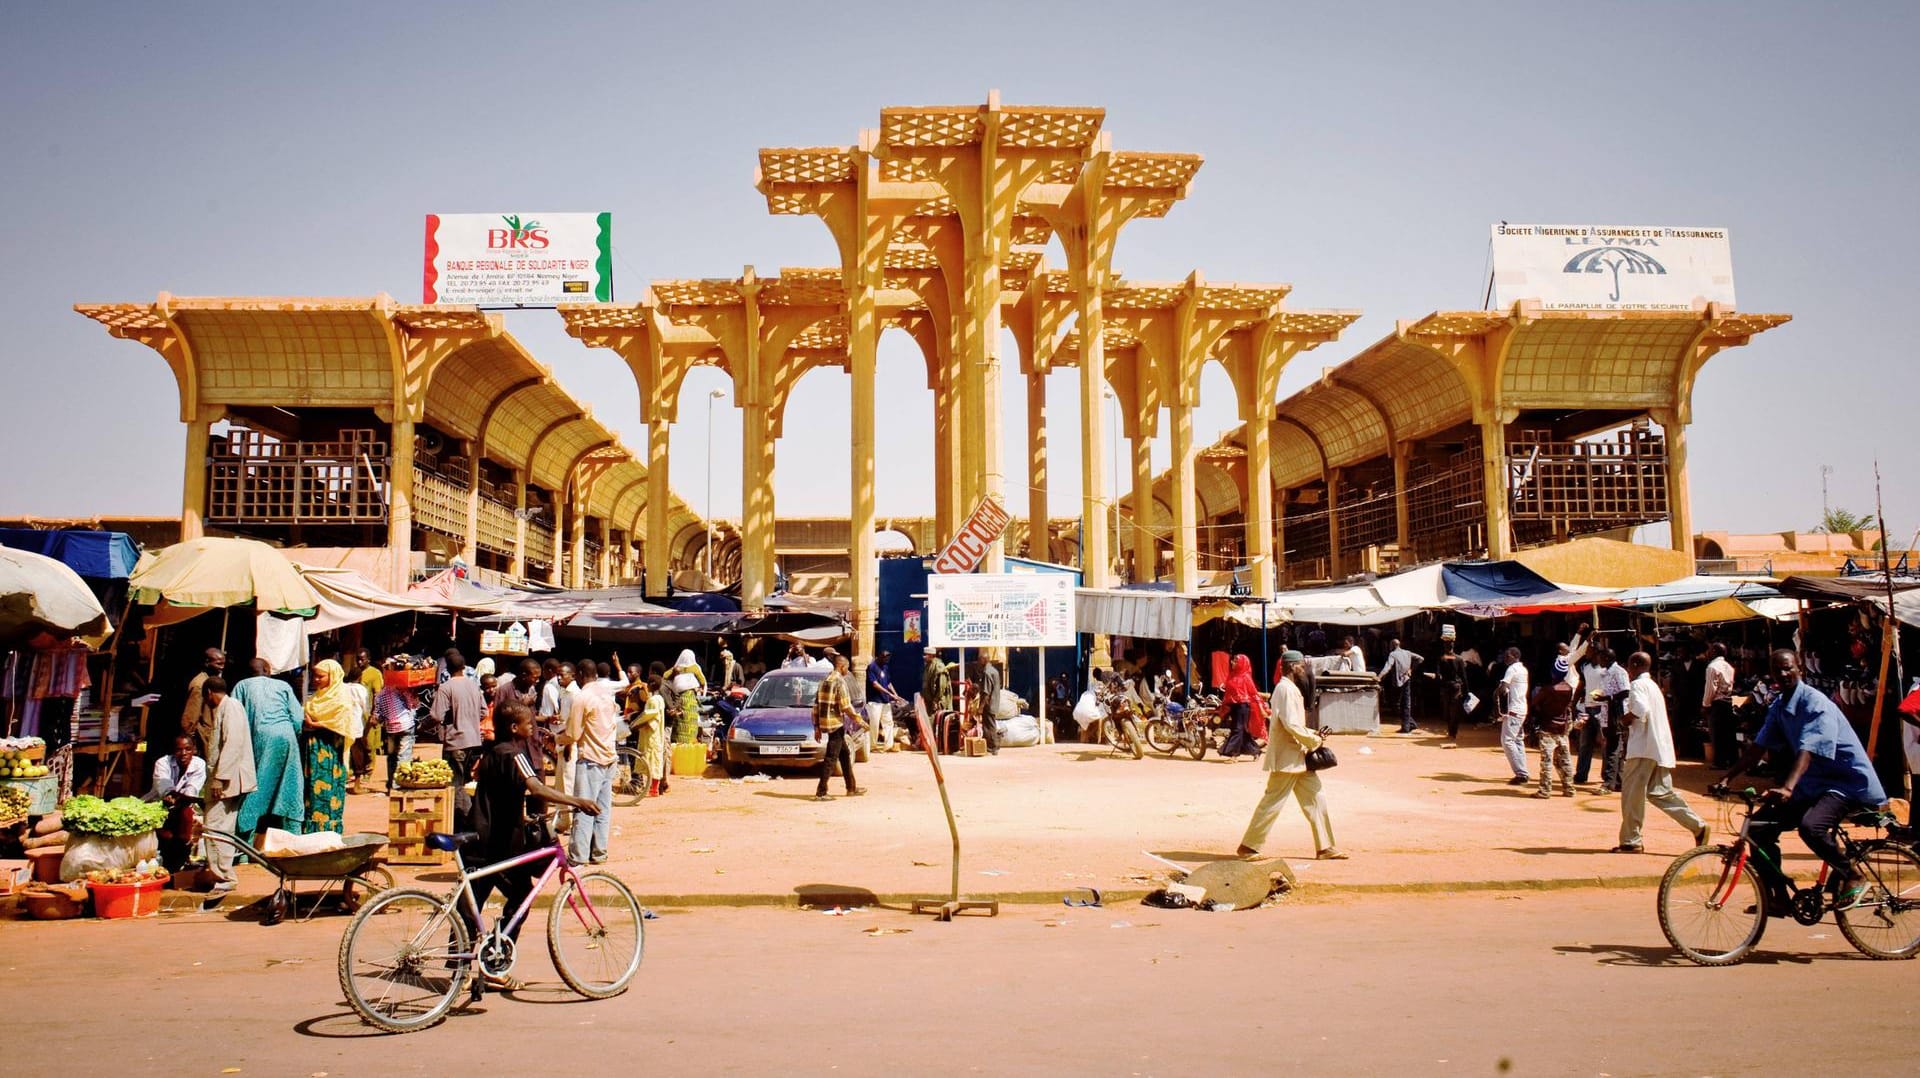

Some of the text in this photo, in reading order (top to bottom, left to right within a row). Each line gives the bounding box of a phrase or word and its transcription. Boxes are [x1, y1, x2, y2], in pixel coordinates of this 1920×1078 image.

[1498, 226, 1532, 235] SOCIETE
[1534, 226, 1579, 236] NIGERIENNE
[1642, 229, 1651, 237] ET
[1653, 229, 1663, 237] DE
[1665, 228, 1724, 239] REASSURANCES
[488, 229, 549, 248] BRS
[1565, 237, 1660, 246] LEYMA
[447, 260, 474, 270] BANQUE
[476, 260, 513, 270] REGIONALE
[516, 260, 526, 270] DE
